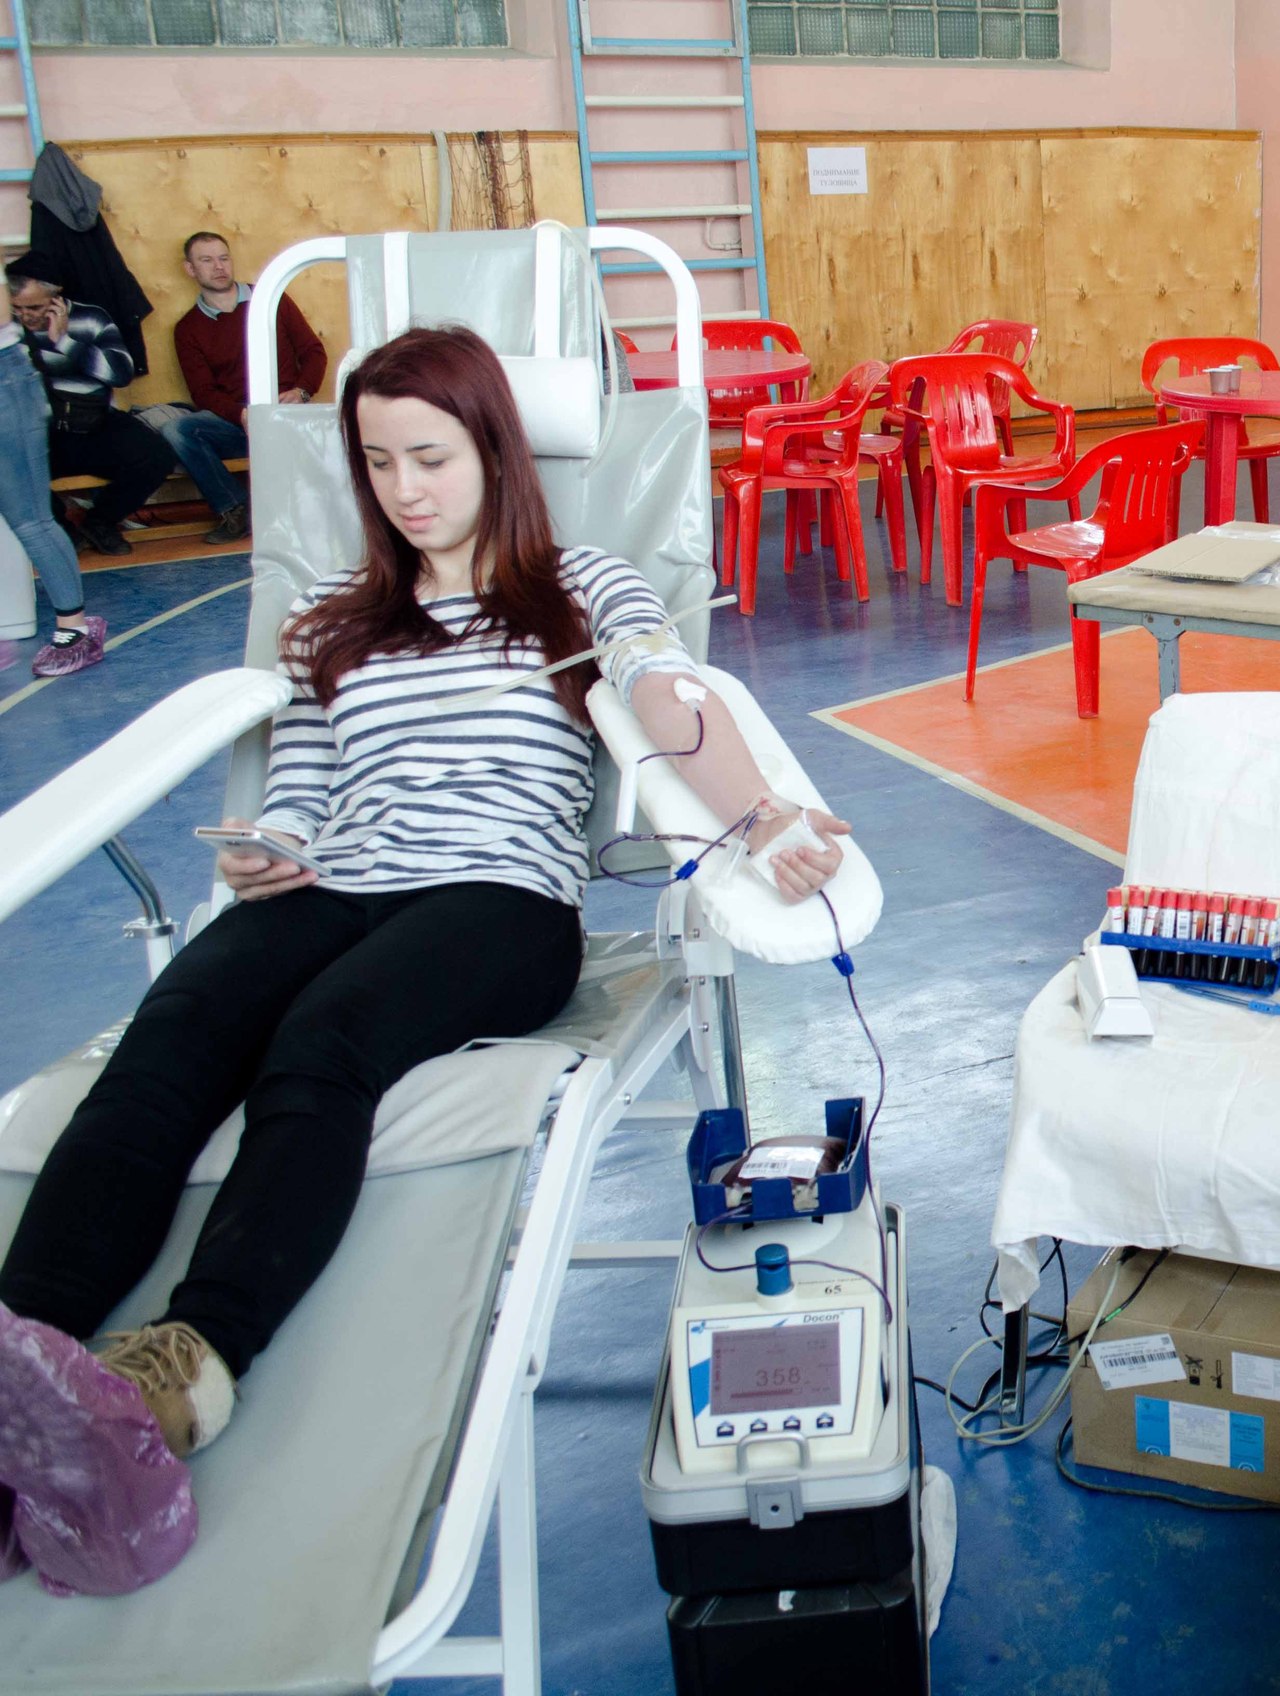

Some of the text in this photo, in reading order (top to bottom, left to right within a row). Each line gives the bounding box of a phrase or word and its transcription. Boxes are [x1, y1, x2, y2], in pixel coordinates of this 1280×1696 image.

[824, 1284, 842, 1295] 65
[803, 1313, 840, 1323] Docon
[755, 1366, 801, 1387] 358
